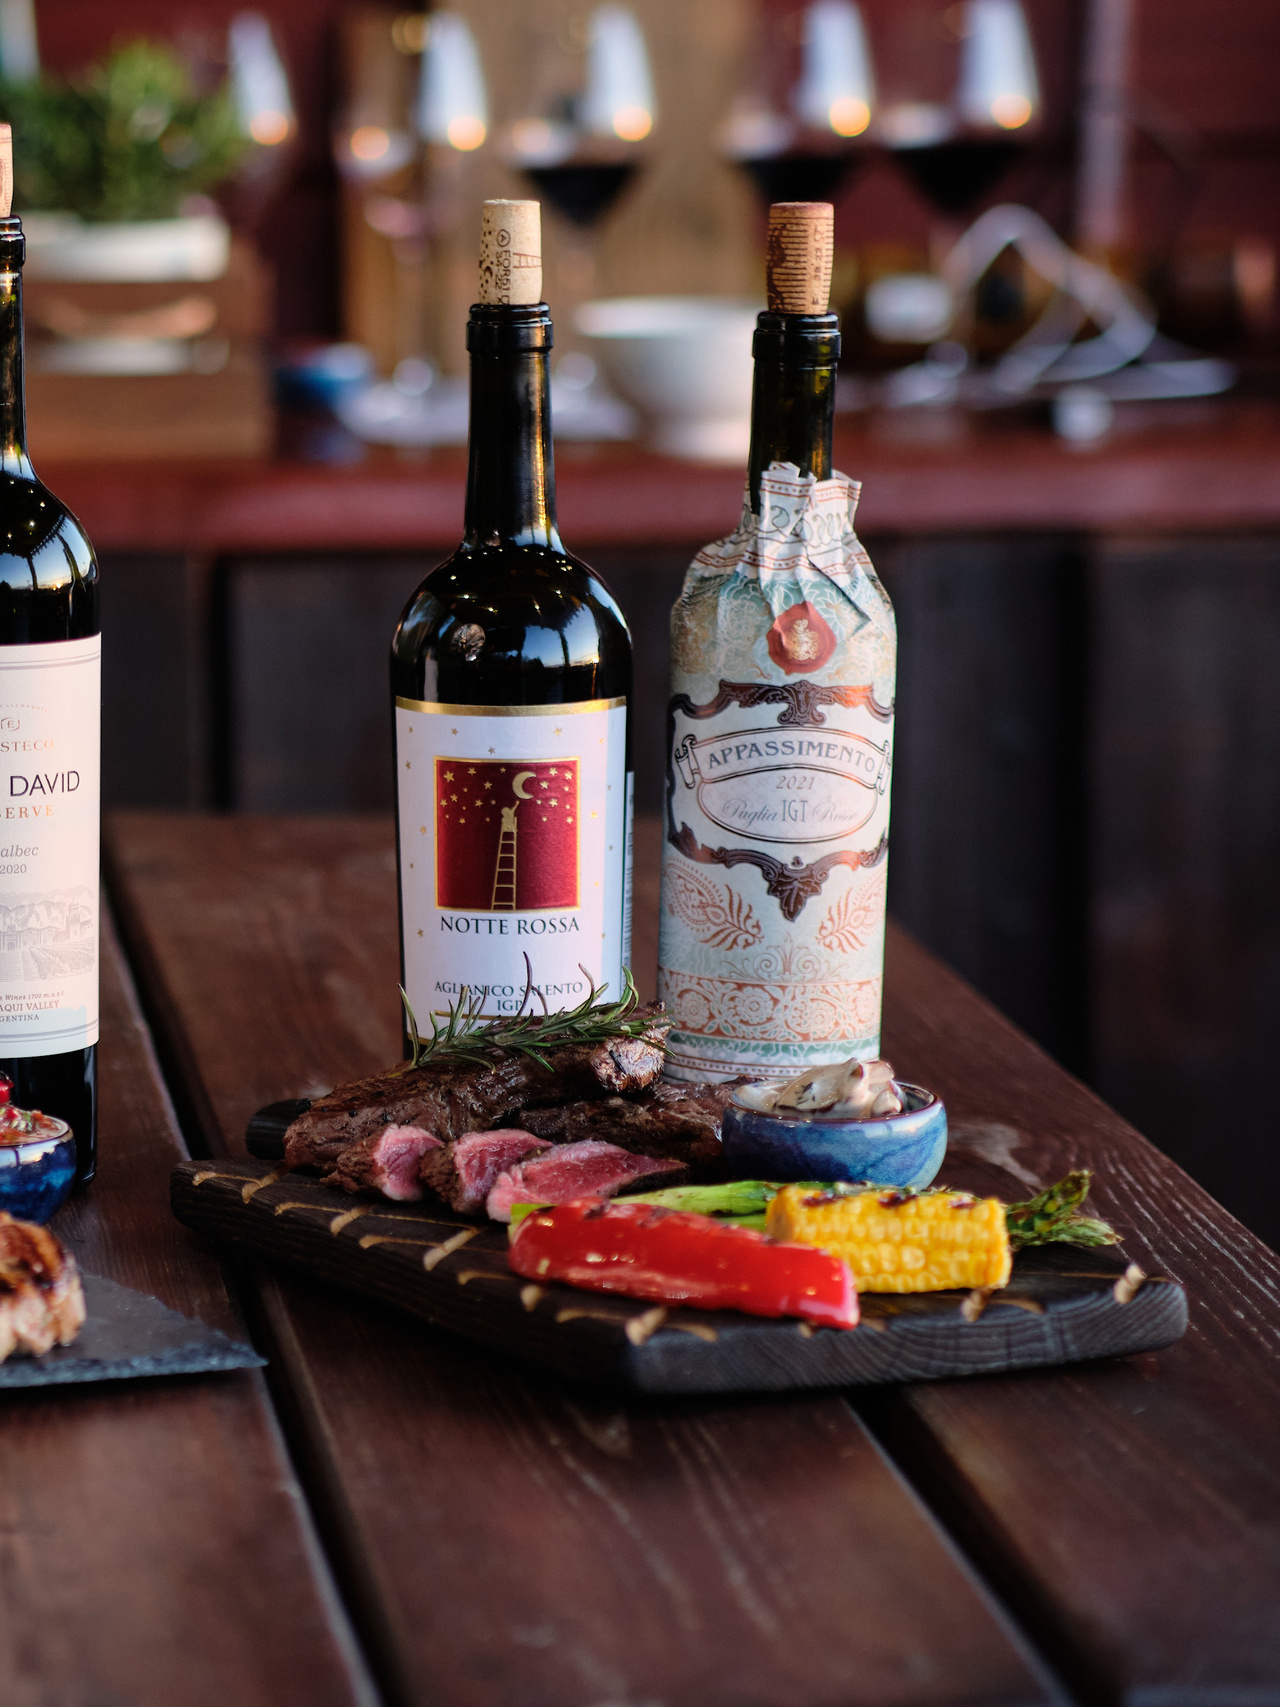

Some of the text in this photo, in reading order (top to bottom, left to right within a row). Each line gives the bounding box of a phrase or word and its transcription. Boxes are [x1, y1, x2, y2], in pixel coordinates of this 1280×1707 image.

[708, 740, 875, 772] APPASSIMENTO
[10, 770, 80, 797] DAVID
[776, 775, 816, 790] 2021
[722, 800, 778, 828] Puglia
[782, 799, 809, 822] IGT
[0, 864, 27, 874] 2020
[440, 916, 579, 934] NOTTE ROSSA
[26, 1000, 60, 1011] VALLEY
[497, 1000, 523, 1011] IGP
